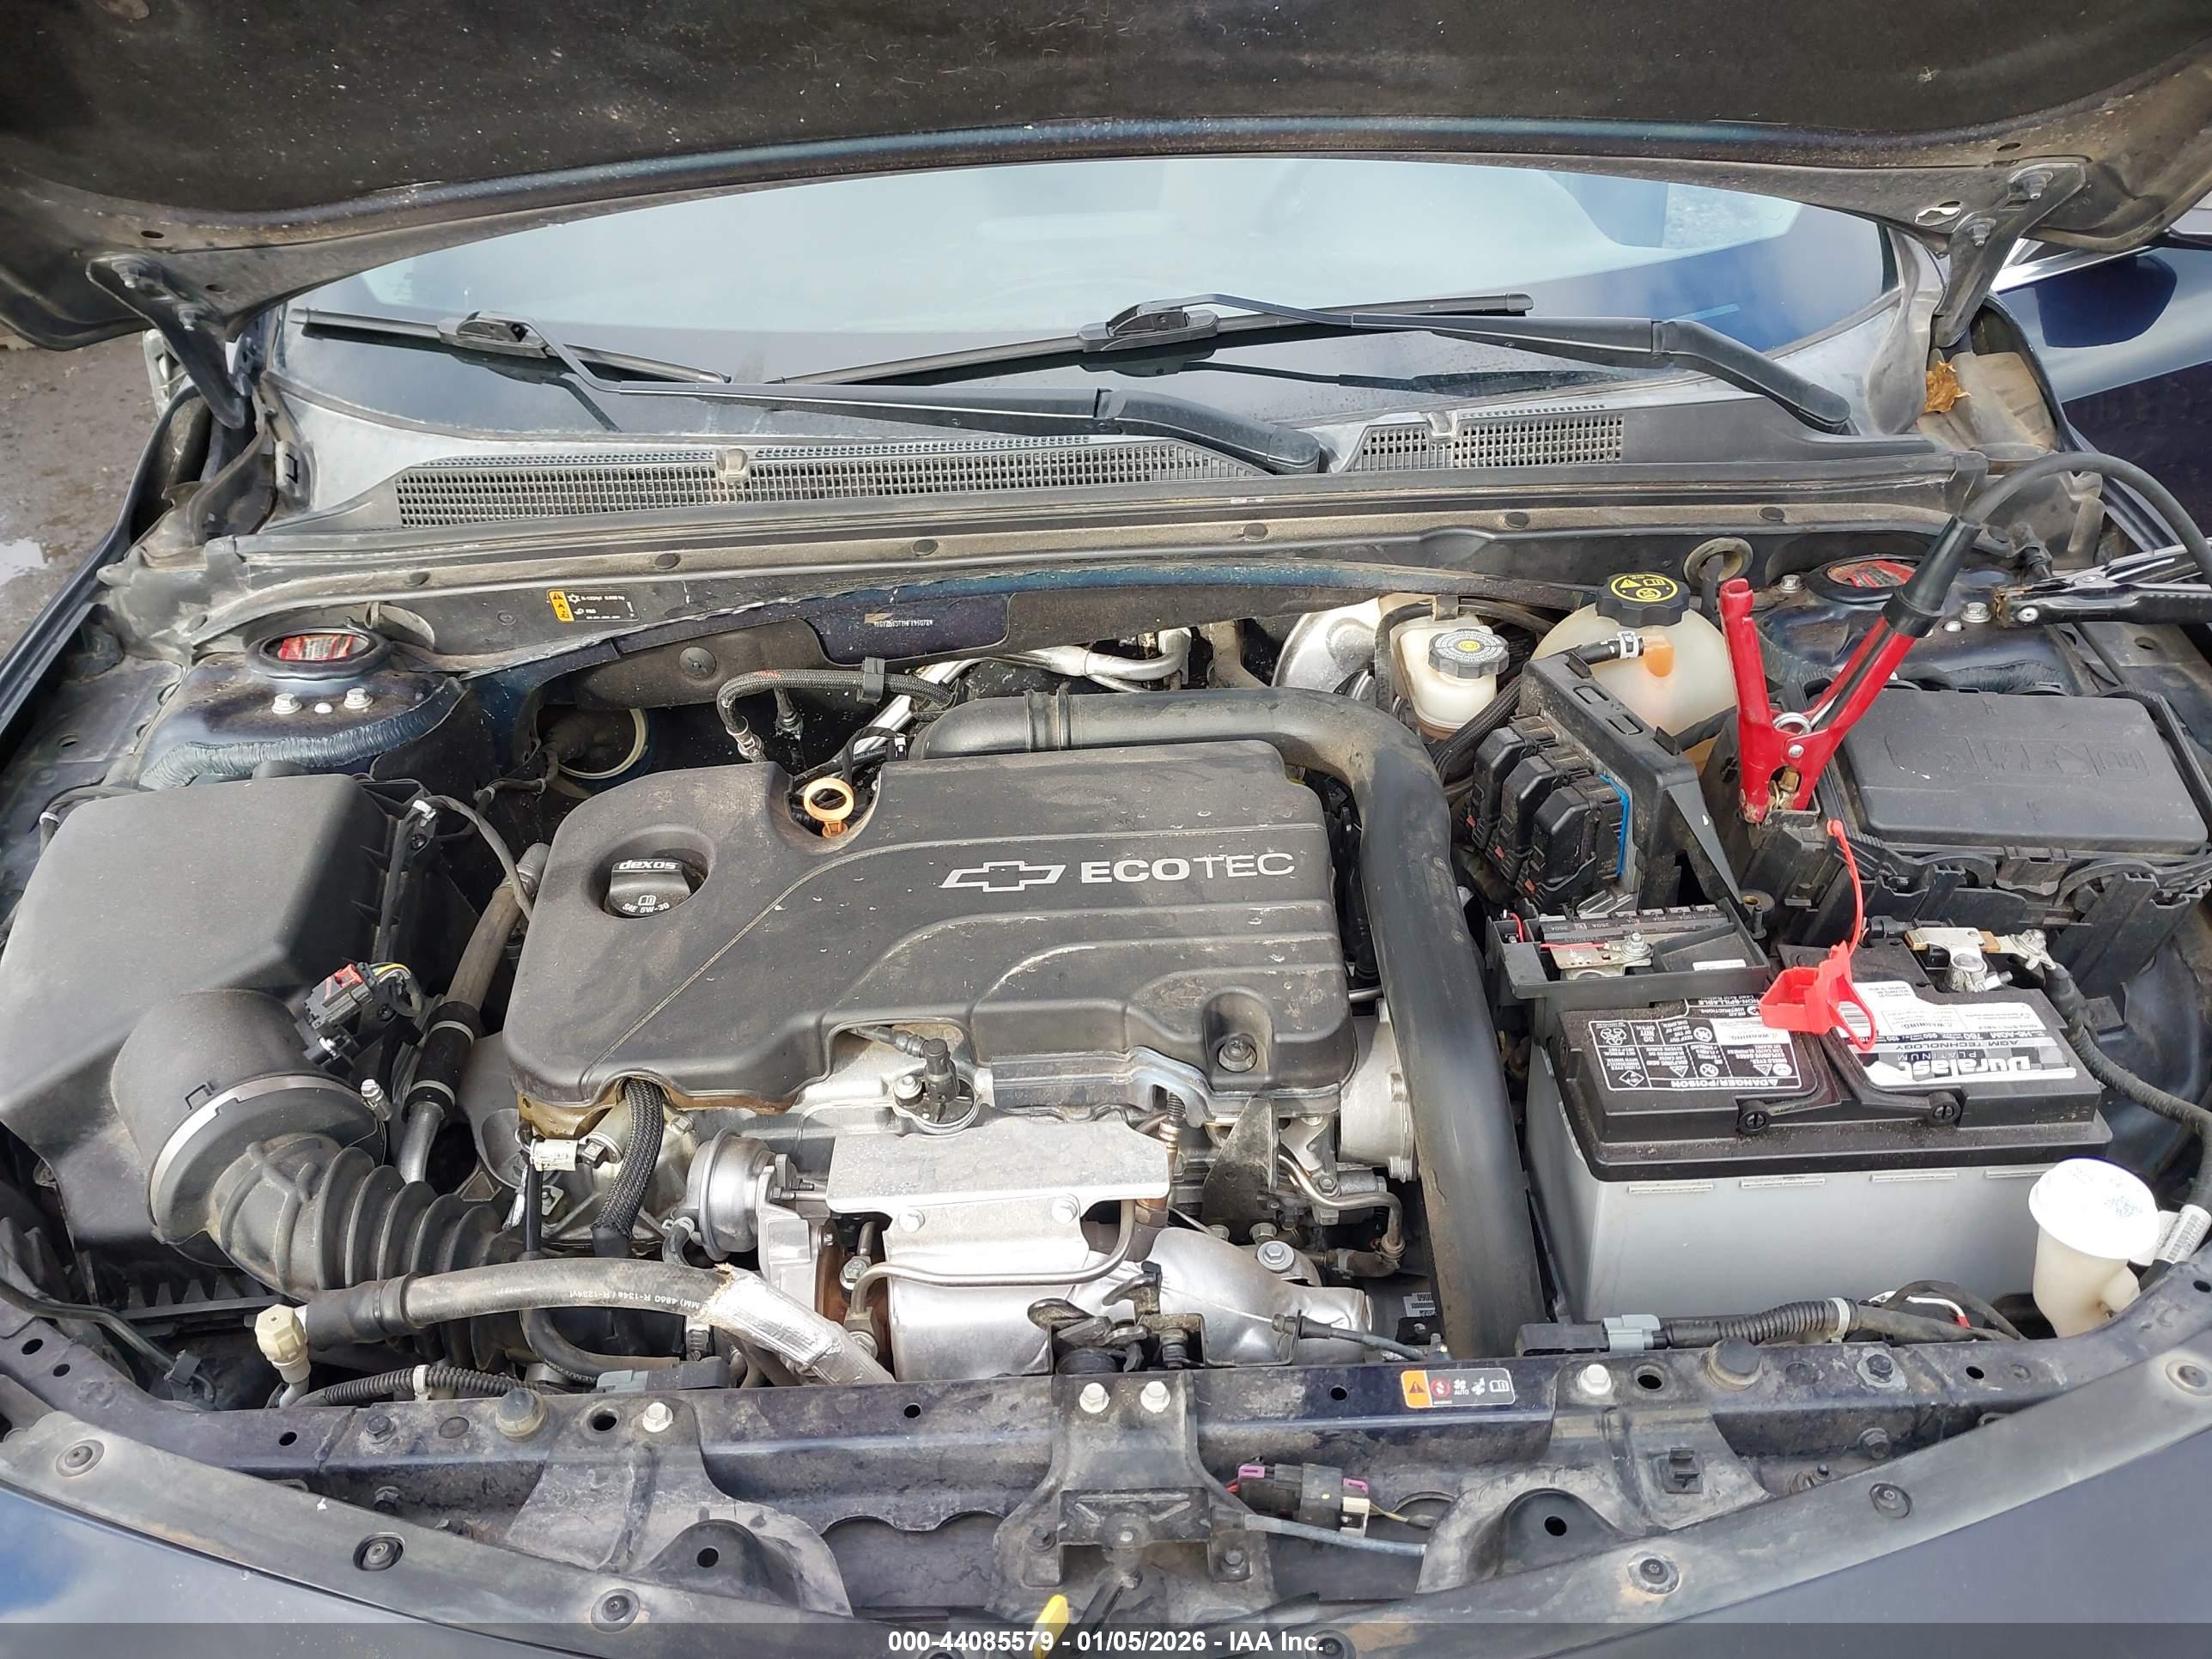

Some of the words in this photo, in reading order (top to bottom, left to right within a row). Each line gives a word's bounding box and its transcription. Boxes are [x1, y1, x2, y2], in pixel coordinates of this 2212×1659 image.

[619, 860, 679, 870] dexos
[1080, 853, 1294, 883] ECOTEC
[623, 902, 638, 912] SAE
[640, 902, 670, 914] 5W-30
[1896, 1041, 1986, 1050] TECHNOLOGY
[1897, 1050, 1977, 1060] PLATINUM
[1898, 1056, 2029, 1074] Duralast
[1671, 1079, 1768, 1087] DANGER/POISON
[618, 1291, 651, 1300] R-134a
[654, 1295, 678, 1304] 4860
